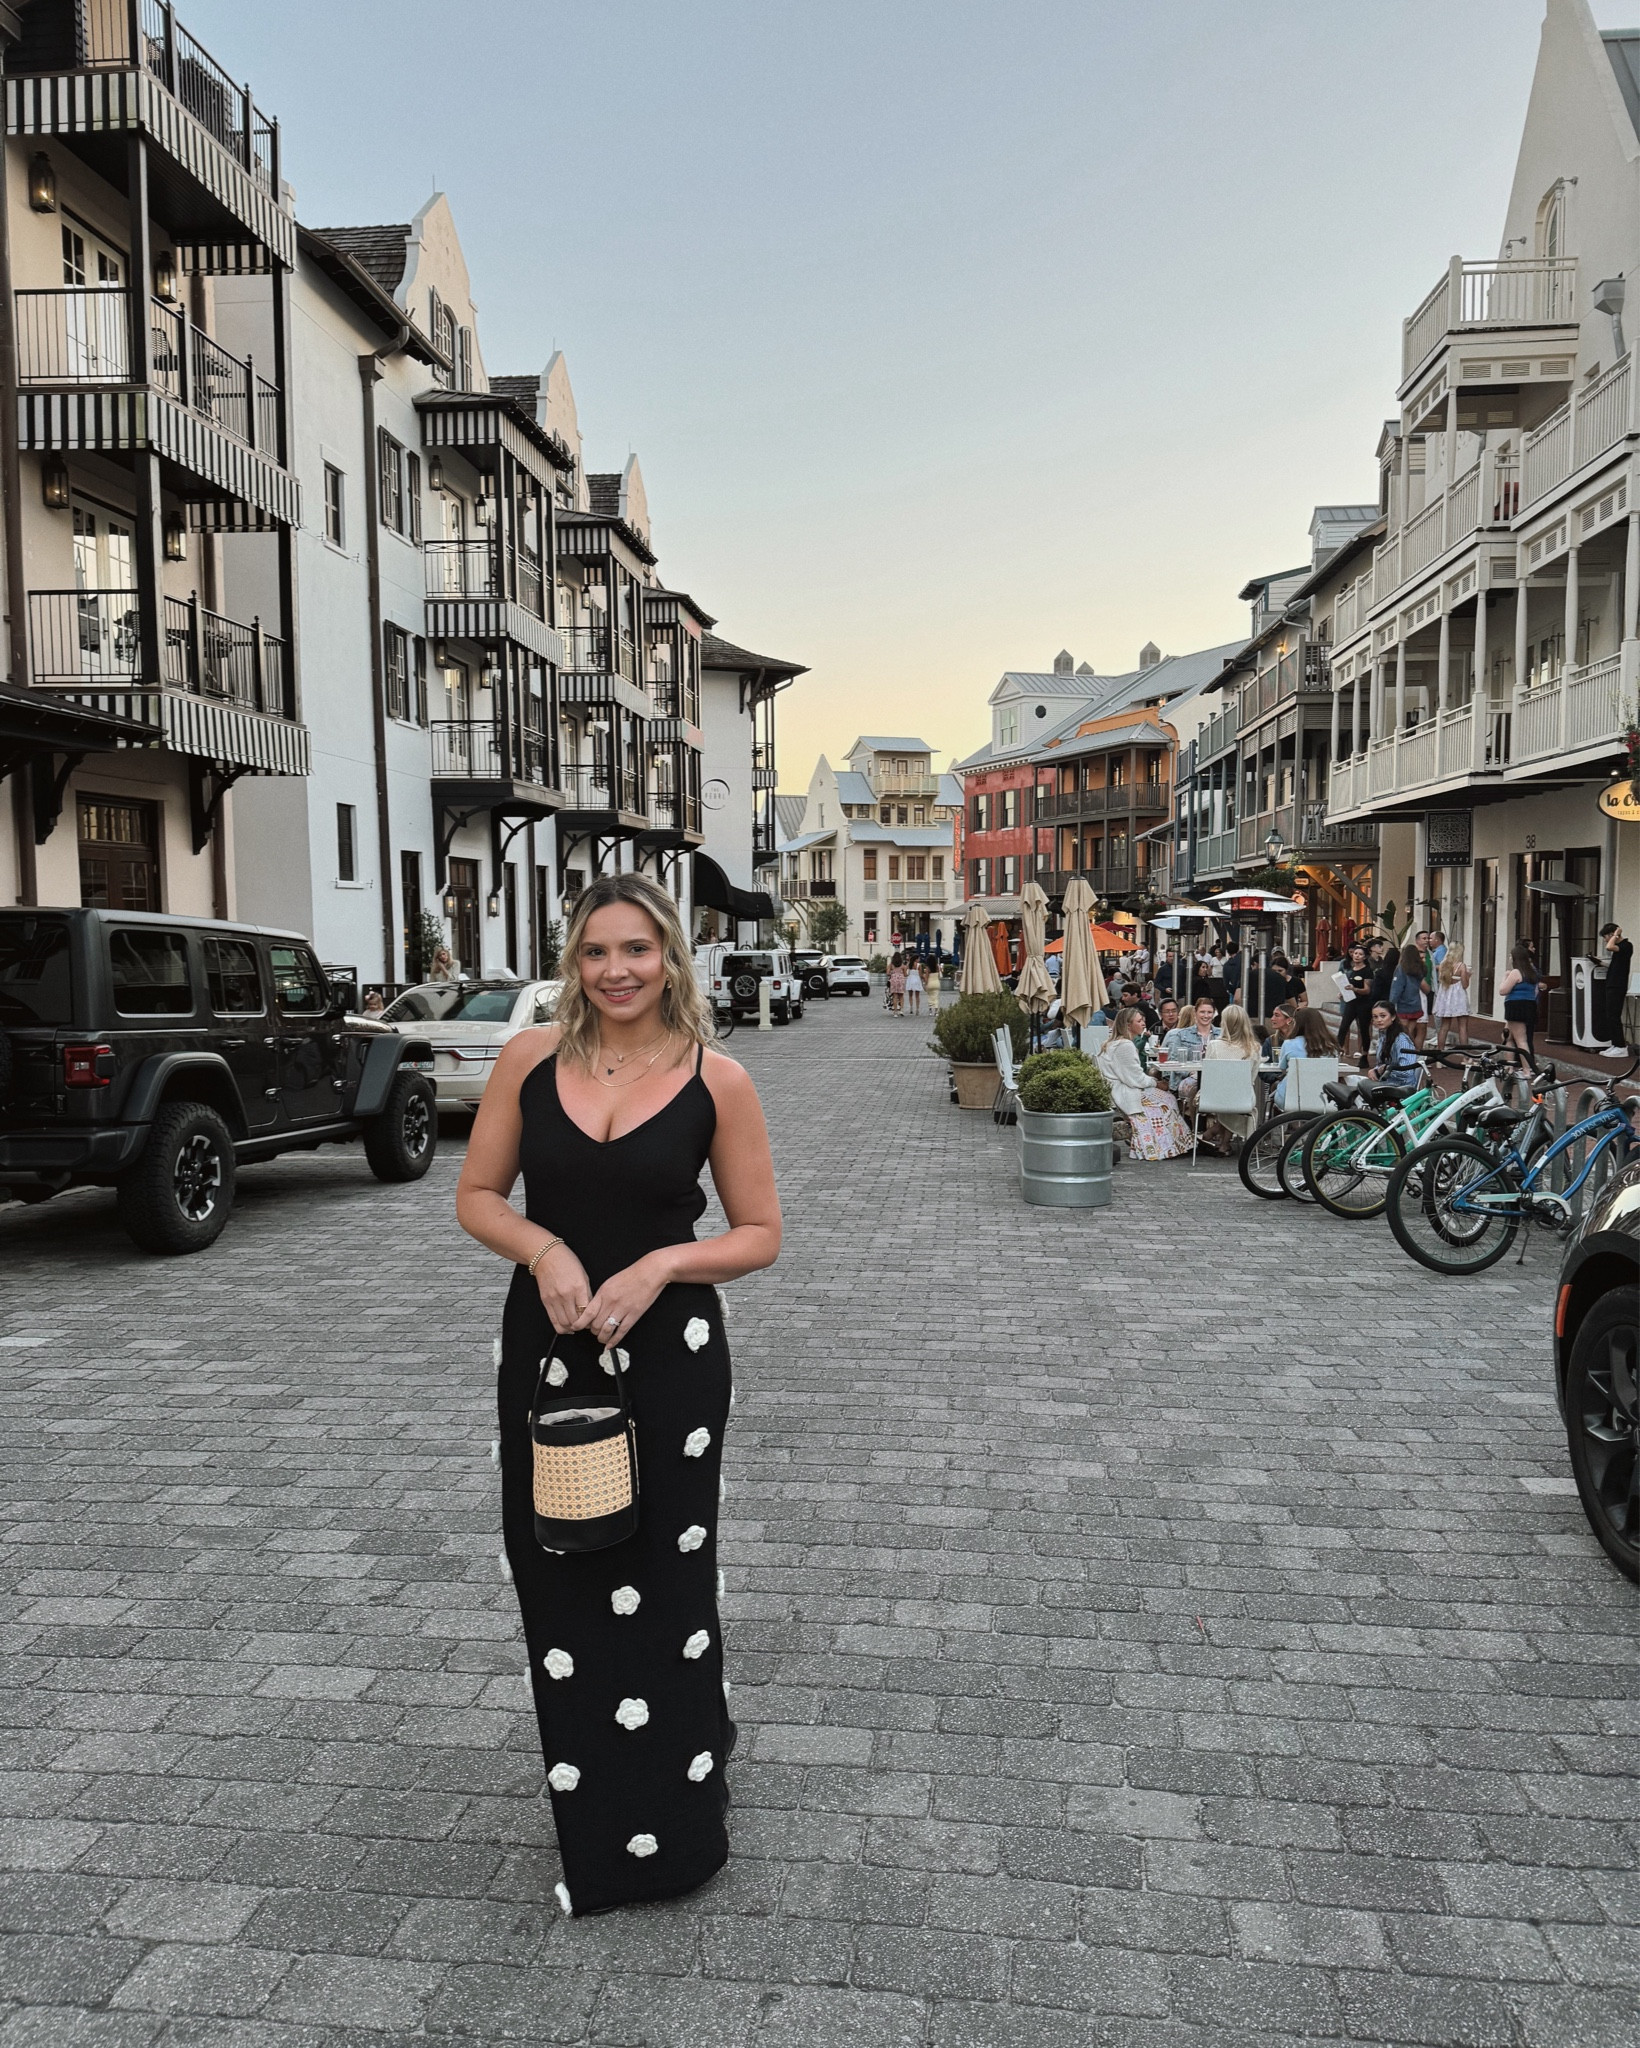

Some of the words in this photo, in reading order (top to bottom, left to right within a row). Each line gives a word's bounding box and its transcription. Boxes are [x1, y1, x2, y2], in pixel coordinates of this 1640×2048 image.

[1606, 793, 1621, 807] la
[1525, 834, 1536, 848] 38
[1570, 1127, 1587, 1140] 30A
